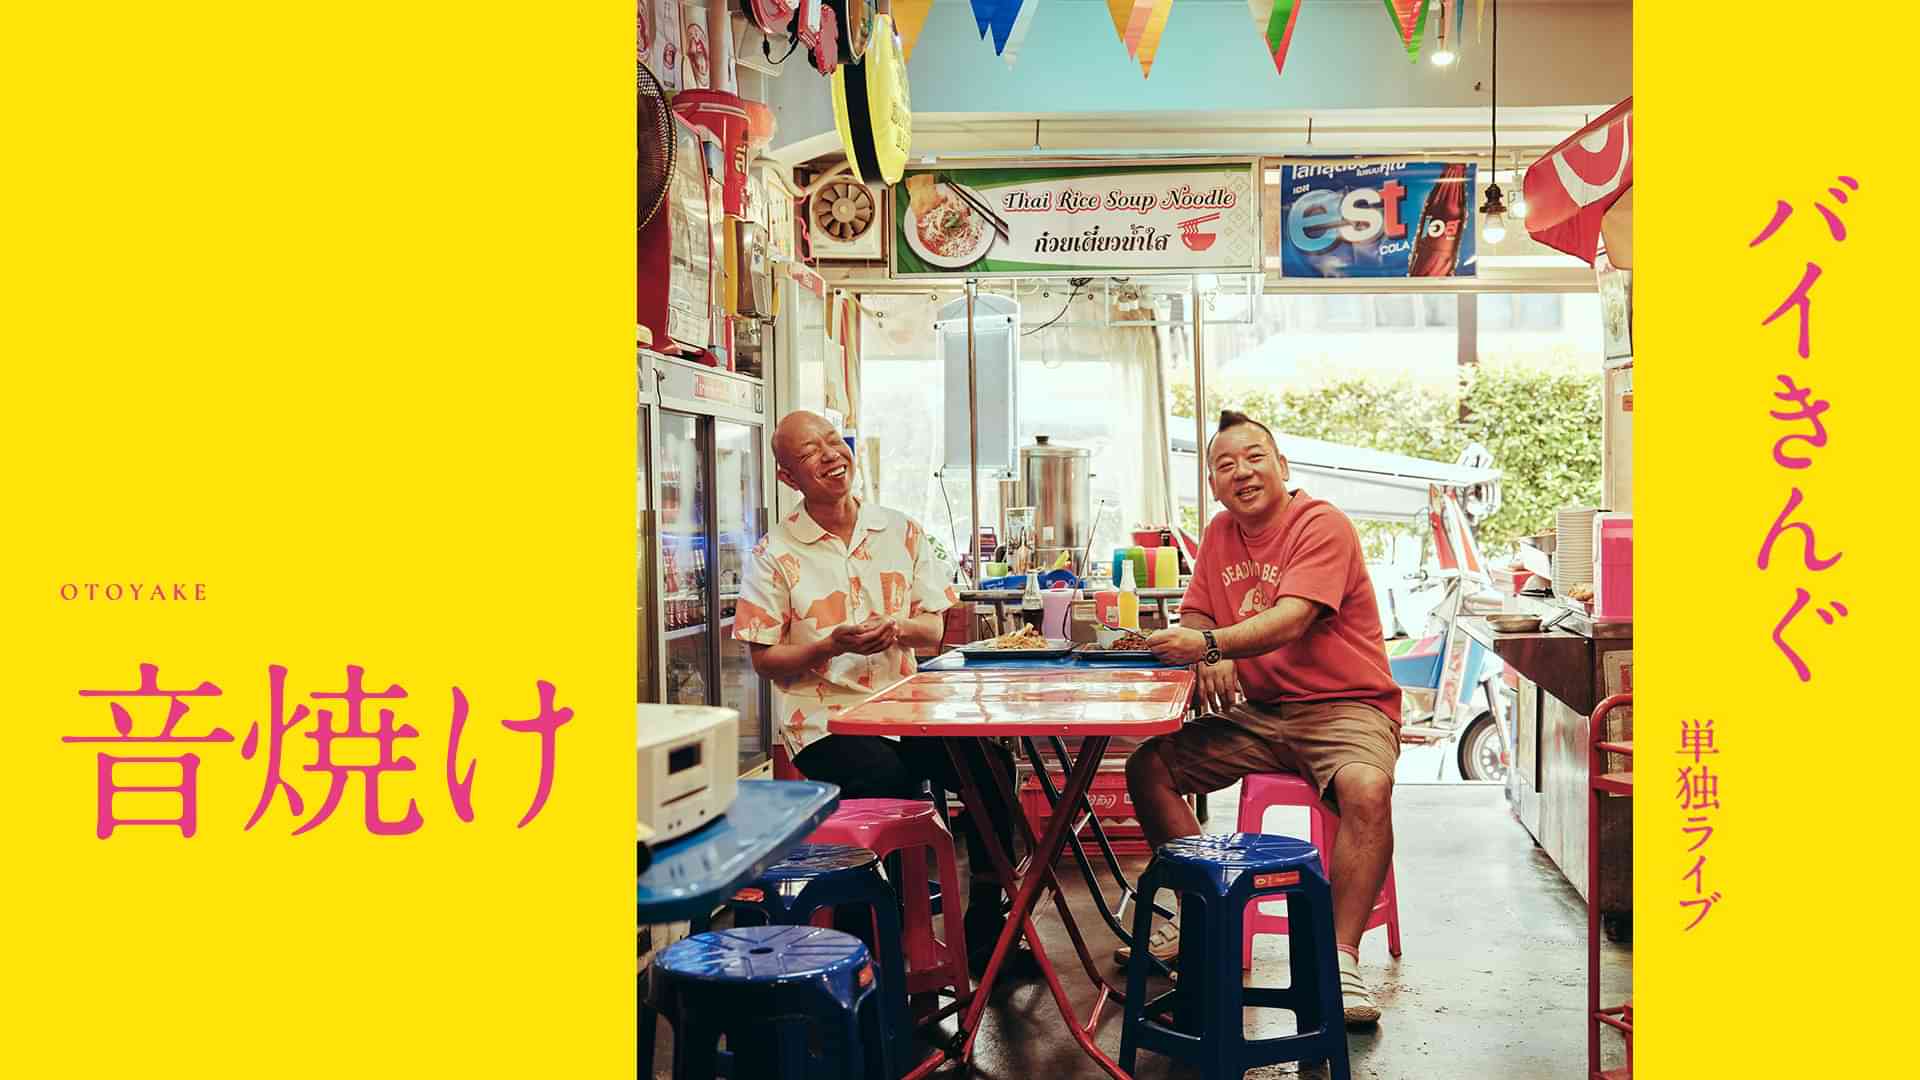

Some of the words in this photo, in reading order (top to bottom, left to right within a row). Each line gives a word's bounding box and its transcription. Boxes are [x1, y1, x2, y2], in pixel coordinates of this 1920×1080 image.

[1004, 191, 1050, 211] Thai
[1058, 189, 1100, 214] Rice
[1105, 189, 1156, 214] Soup
[1161, 186, 1235, 210] Noodle
[1287, 179, 1406, 252] est
[1379, 240, 1410, 256] COLA
